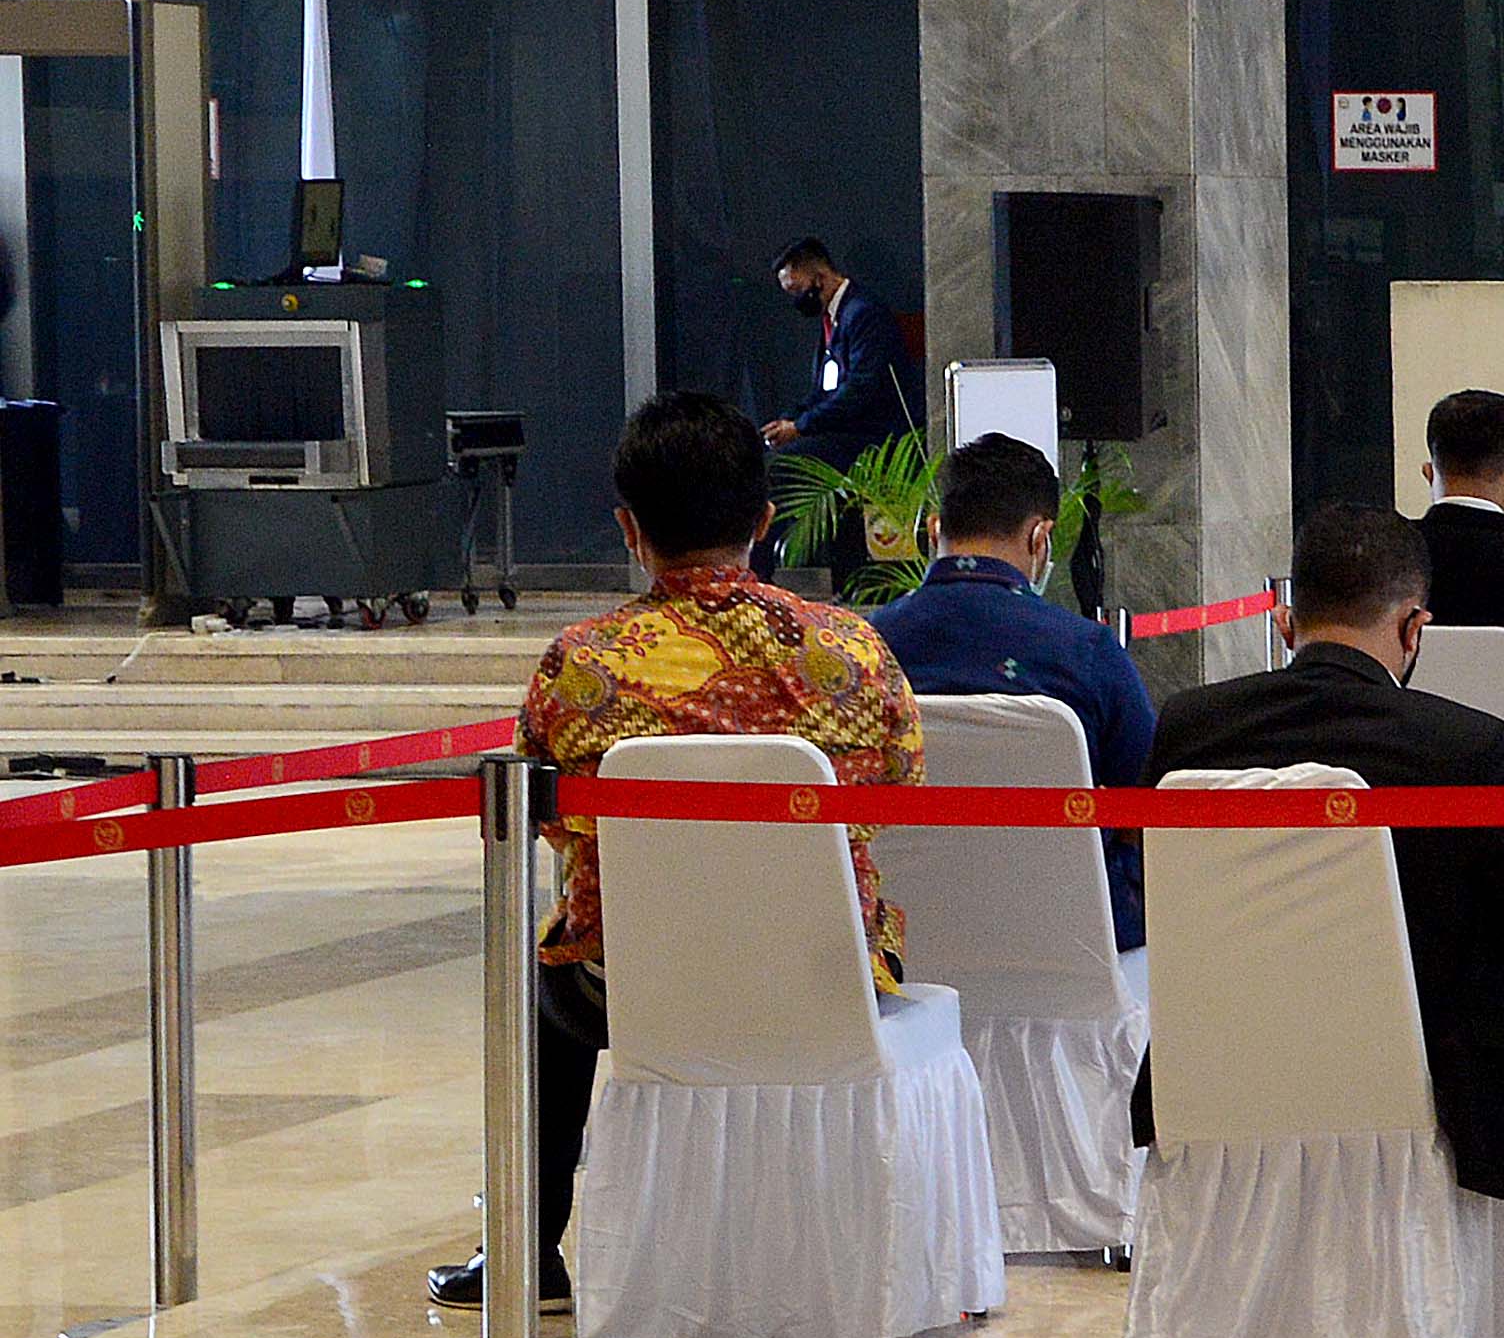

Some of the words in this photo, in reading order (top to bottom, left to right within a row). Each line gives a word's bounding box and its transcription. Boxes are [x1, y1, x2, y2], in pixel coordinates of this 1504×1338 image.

[1350, 123, 1381, 134] AREA
[1384, 123, 1420, 134] WAJIB
[1340, 137, 1431, 149] MENGGUNAKAN
[1361, 151, 1409, 162] MASKER
